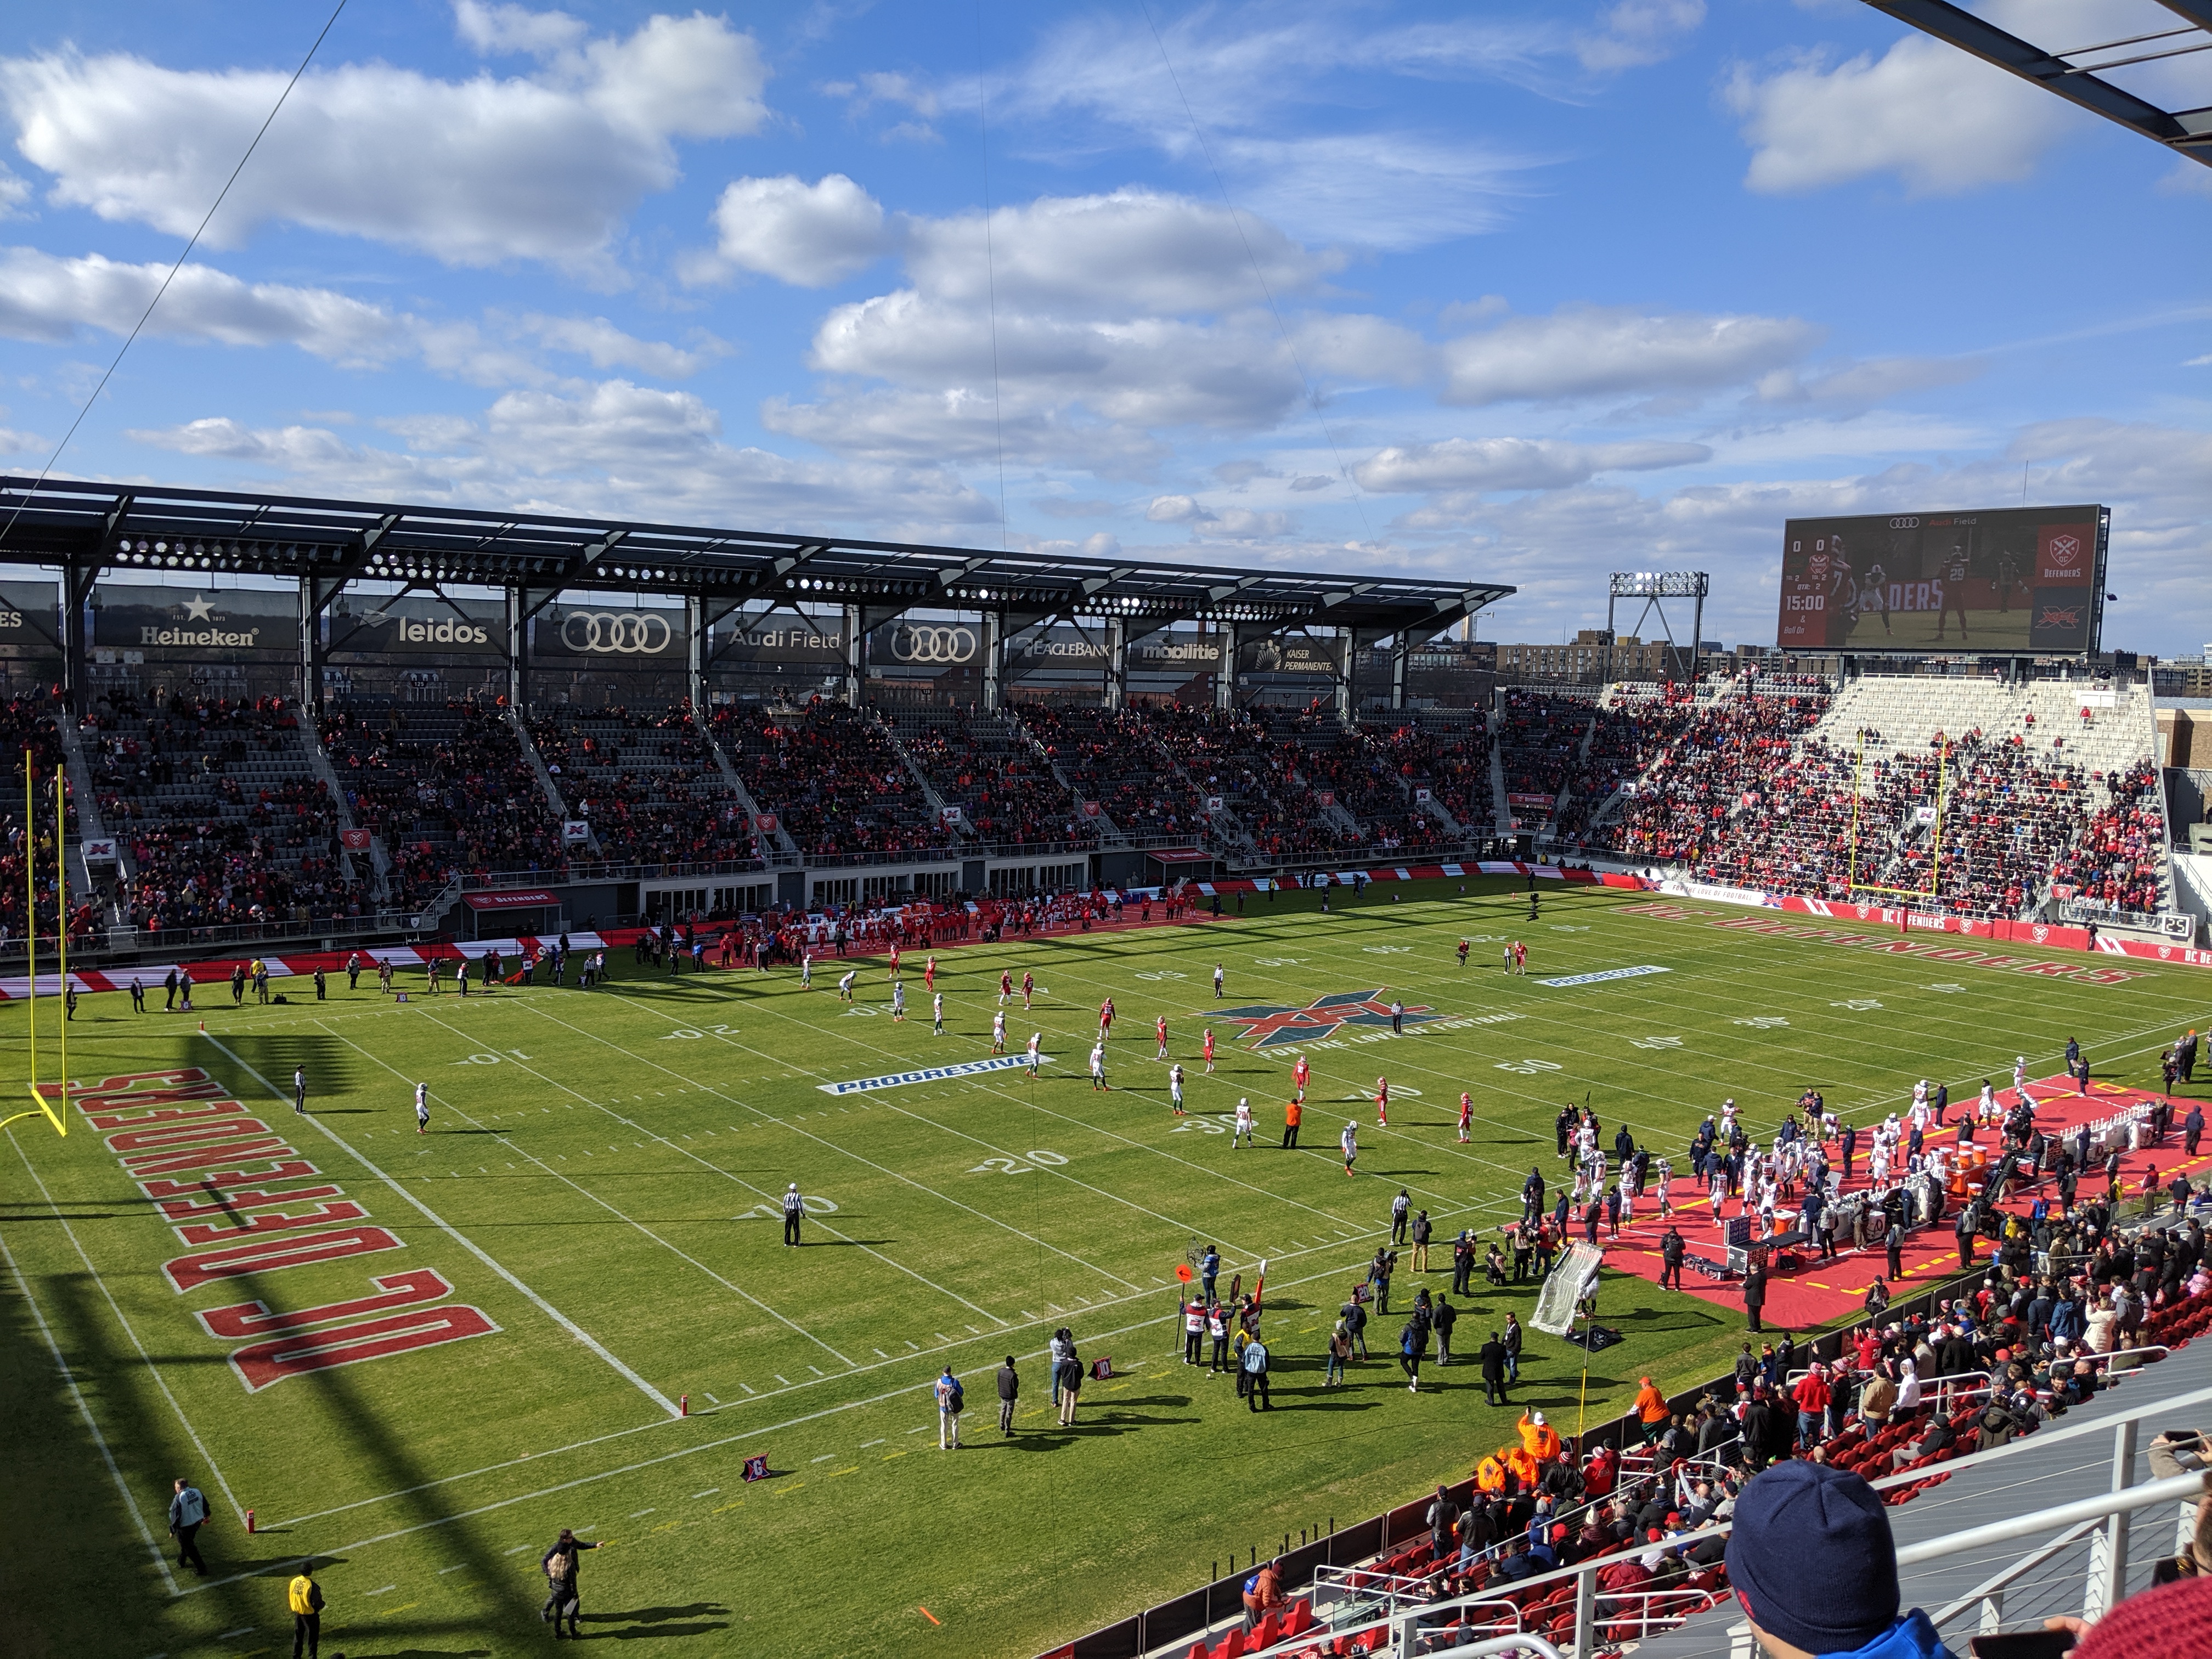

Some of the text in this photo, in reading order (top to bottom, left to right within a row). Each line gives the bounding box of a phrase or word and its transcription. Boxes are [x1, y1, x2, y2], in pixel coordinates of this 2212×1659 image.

[1954, 517, 1977, 526] Field
[1793, 539, 1825, 552] 0 0
[2044, 568, 2081, 578] DEFENDERS
[1786, 595, 1825, 611] 15:00
[399, 616, 488, 644] leidos
[1796, 626, 1805, 634] On
[728, 629, 840, 649] Audi Field
[1143, 644, 1219, 660] mobilitie
[1286, 649, 1310, 658] KAISER
[494, 895, 549, 903] DEFENDERS
[1723, 891, 1752, 901] FOOTBALL
[1882, 909, 1894, 923] DC
[2165, 918, 2185, 932] 25
[1610, 903, 1724, 921] DC
[1704, 916, 2160, 985] DEFENDERS
[2185, 950, 2197, 962] DC
[1548, 966, 1656, 986] PROGRESSIVE
[1257, 1011, 1527, 1059] FOR THE LOVE OF FOOTBALL
[837, 1053, 1034, 1093] PROGRESSIVE
[1493, 1059, 1564, 1074] 50
[983, 1150, 1069, 1176] 20
[27, 1066, 408, 1295] DEFENDERS
[1357, 1285, 1370, 1300] 20
[191, 1267, 505, 1395] DC
[1099, 1361, 1110, 1376] 10
[753, 1459, 763, 1476] G
